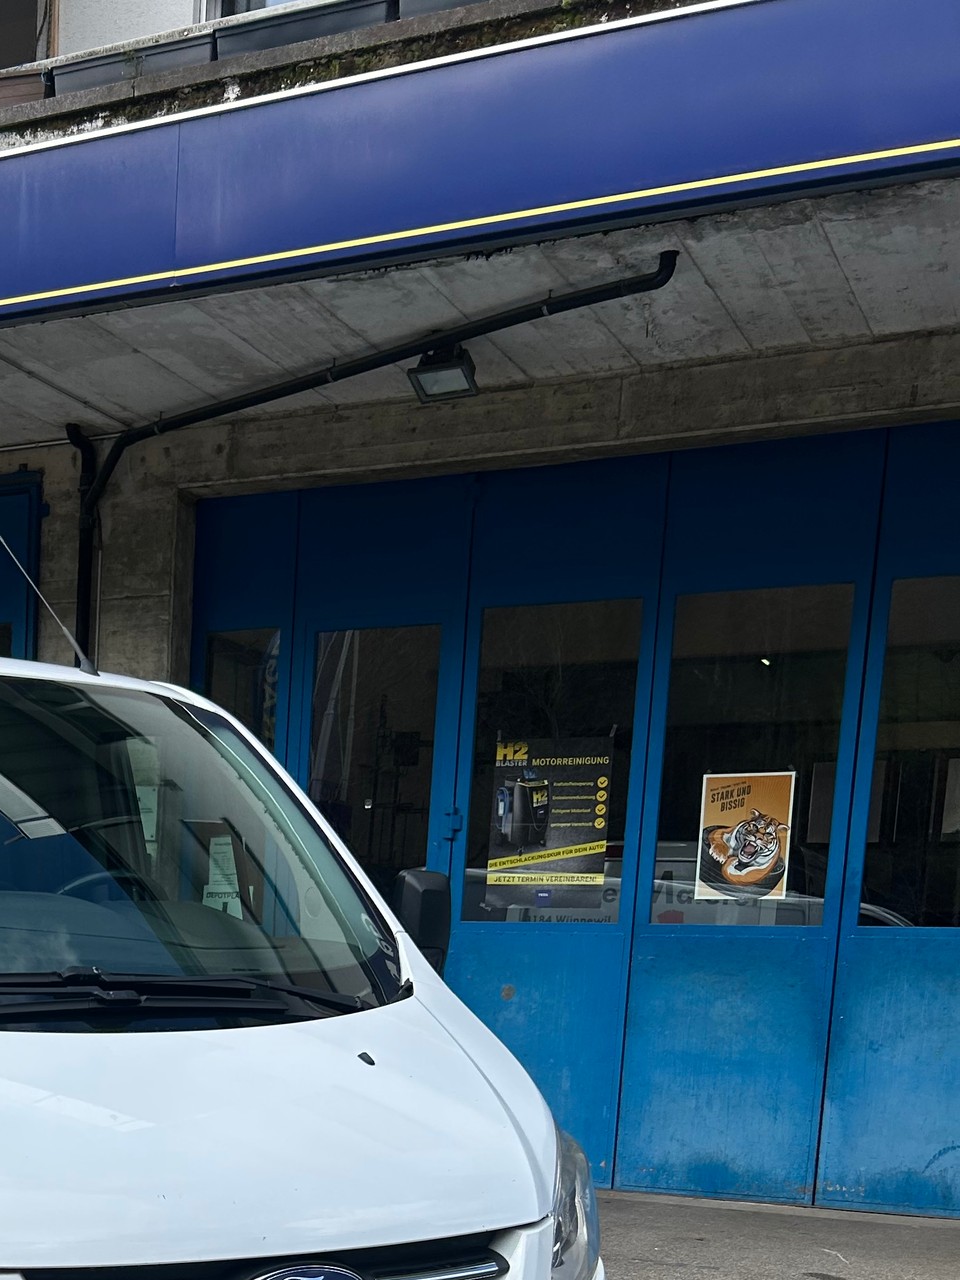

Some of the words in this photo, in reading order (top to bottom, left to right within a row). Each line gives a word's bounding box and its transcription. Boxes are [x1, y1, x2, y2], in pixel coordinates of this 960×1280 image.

[496, 742, 529, 760] H2
[495, 759, 528, 767] BLASTER
[531, 756, 610, 767] MOTORREINIGUNG
[710, 789, 735, 803] STARK
[736, 784, 752, 798] UND
[720, 797, 746, 812] BISSIG
[493, 875, 516, 883] JETZT
[516, 875, 544, 883] TERMIN
[545, 875, 597, 883] VEREINBAREN!
